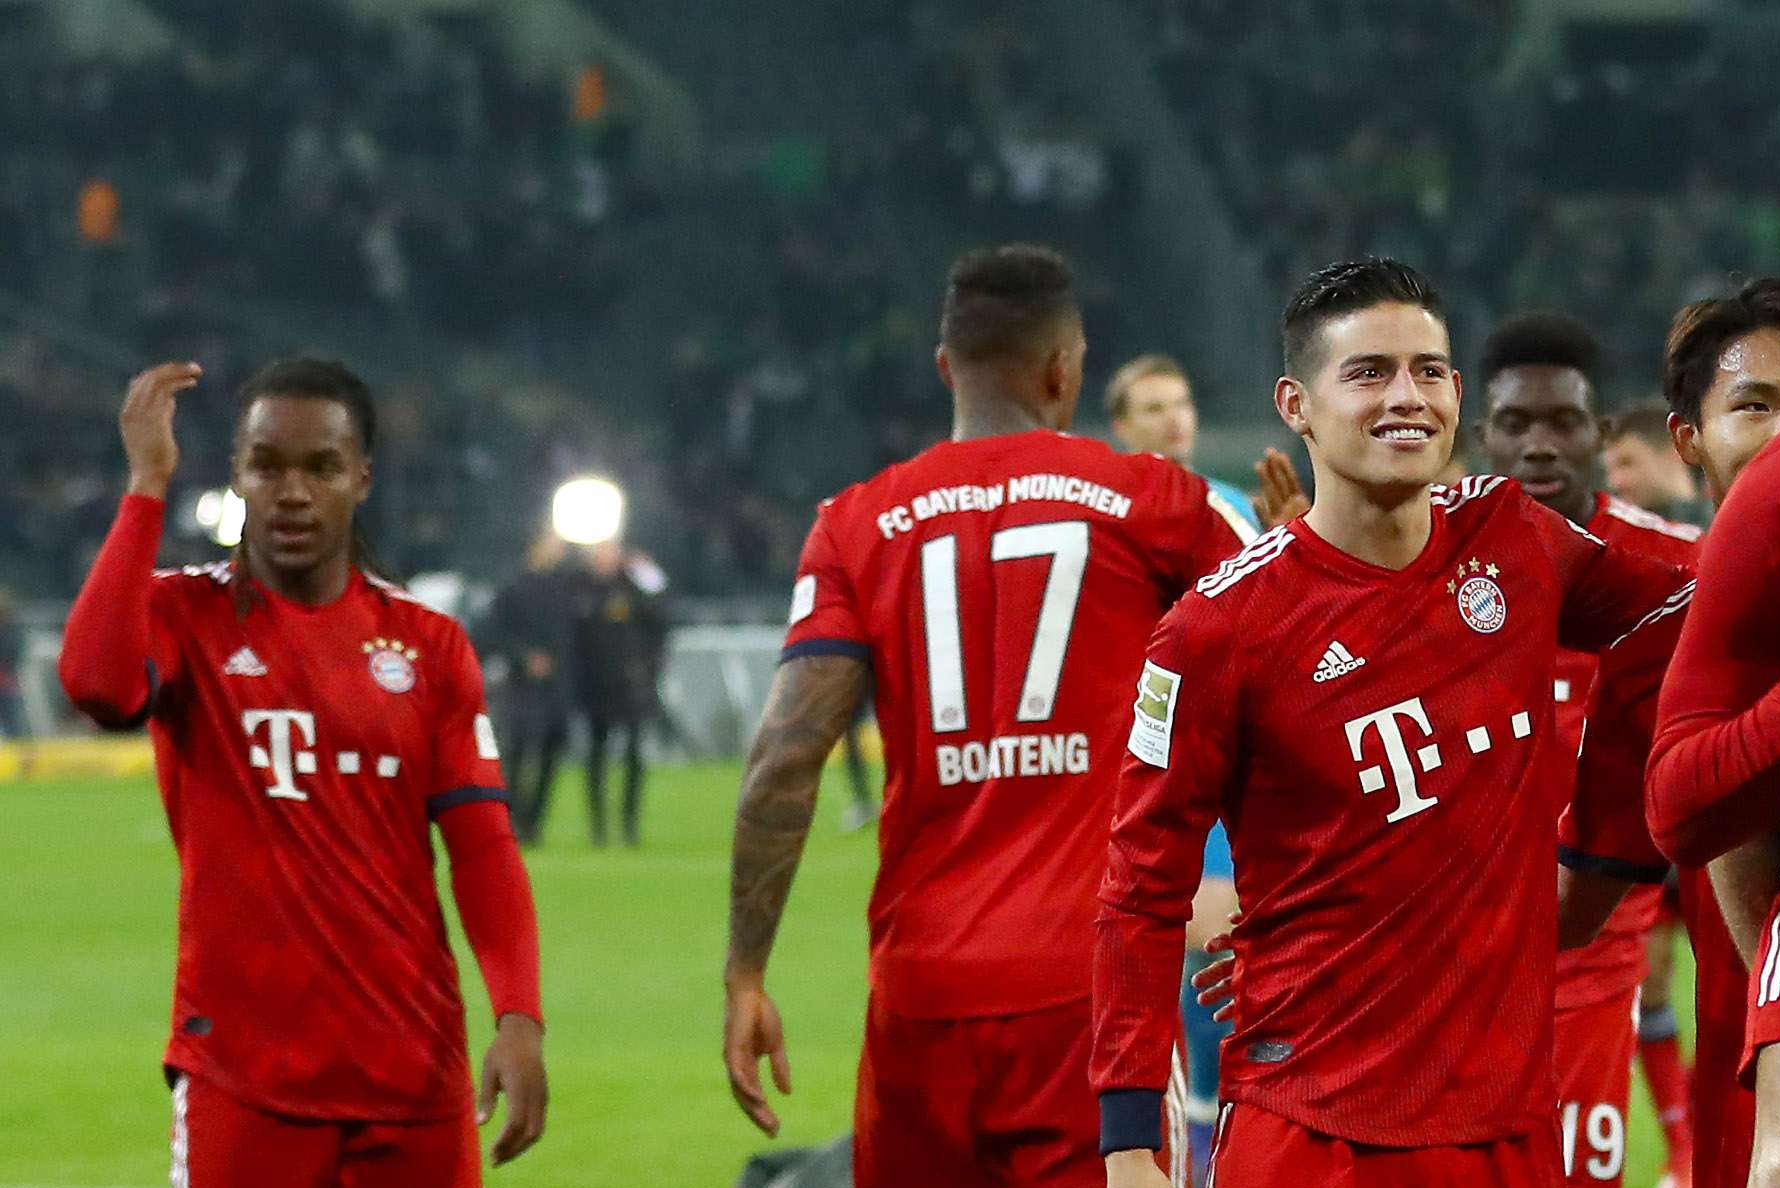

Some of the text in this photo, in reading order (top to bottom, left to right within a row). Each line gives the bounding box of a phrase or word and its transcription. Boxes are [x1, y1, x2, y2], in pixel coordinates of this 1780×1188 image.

[877, 505, 914, 540] FC
[911, 482, 1005, 521] BAYERN
[920, 519, 1091, 733] 17
[1313, 656, 1367, 682] adidas
[936, 733, 1090, 786] BOATENG
[1562, 1103, 1624, 1180] 19
